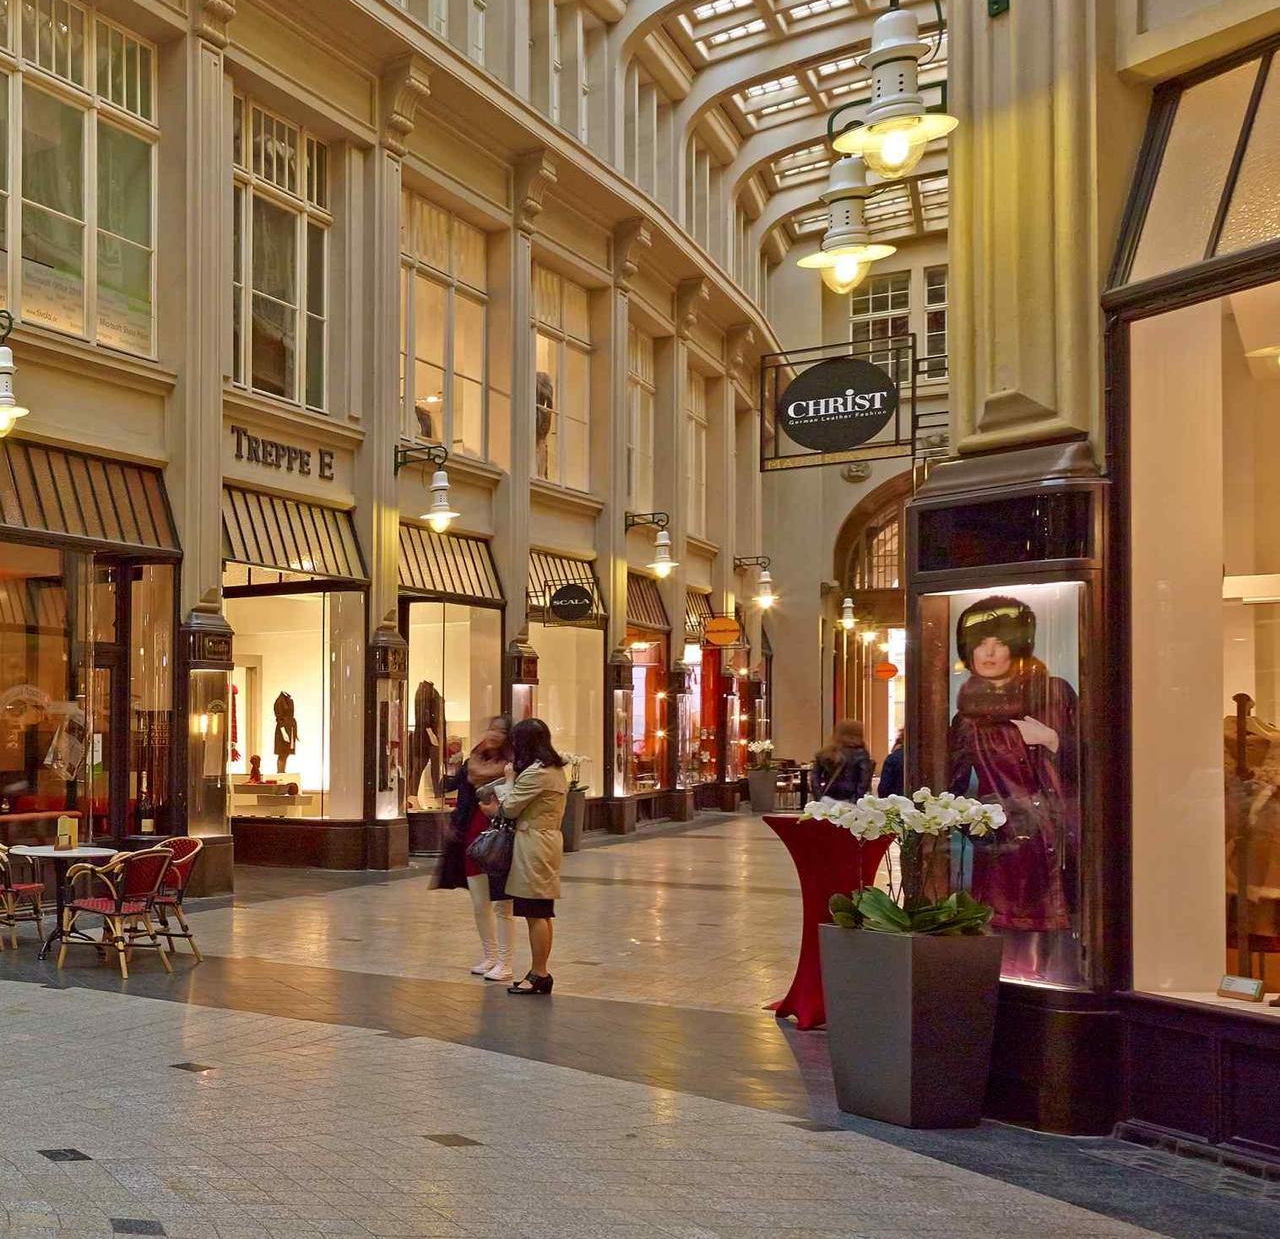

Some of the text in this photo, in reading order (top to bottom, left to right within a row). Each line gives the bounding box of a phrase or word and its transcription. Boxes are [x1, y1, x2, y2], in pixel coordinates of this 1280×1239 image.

[788, 410, 887, 426] German Leather Fashion
[318, 448, 335, 481] E
[553, 598, 589, 606] SCALA
